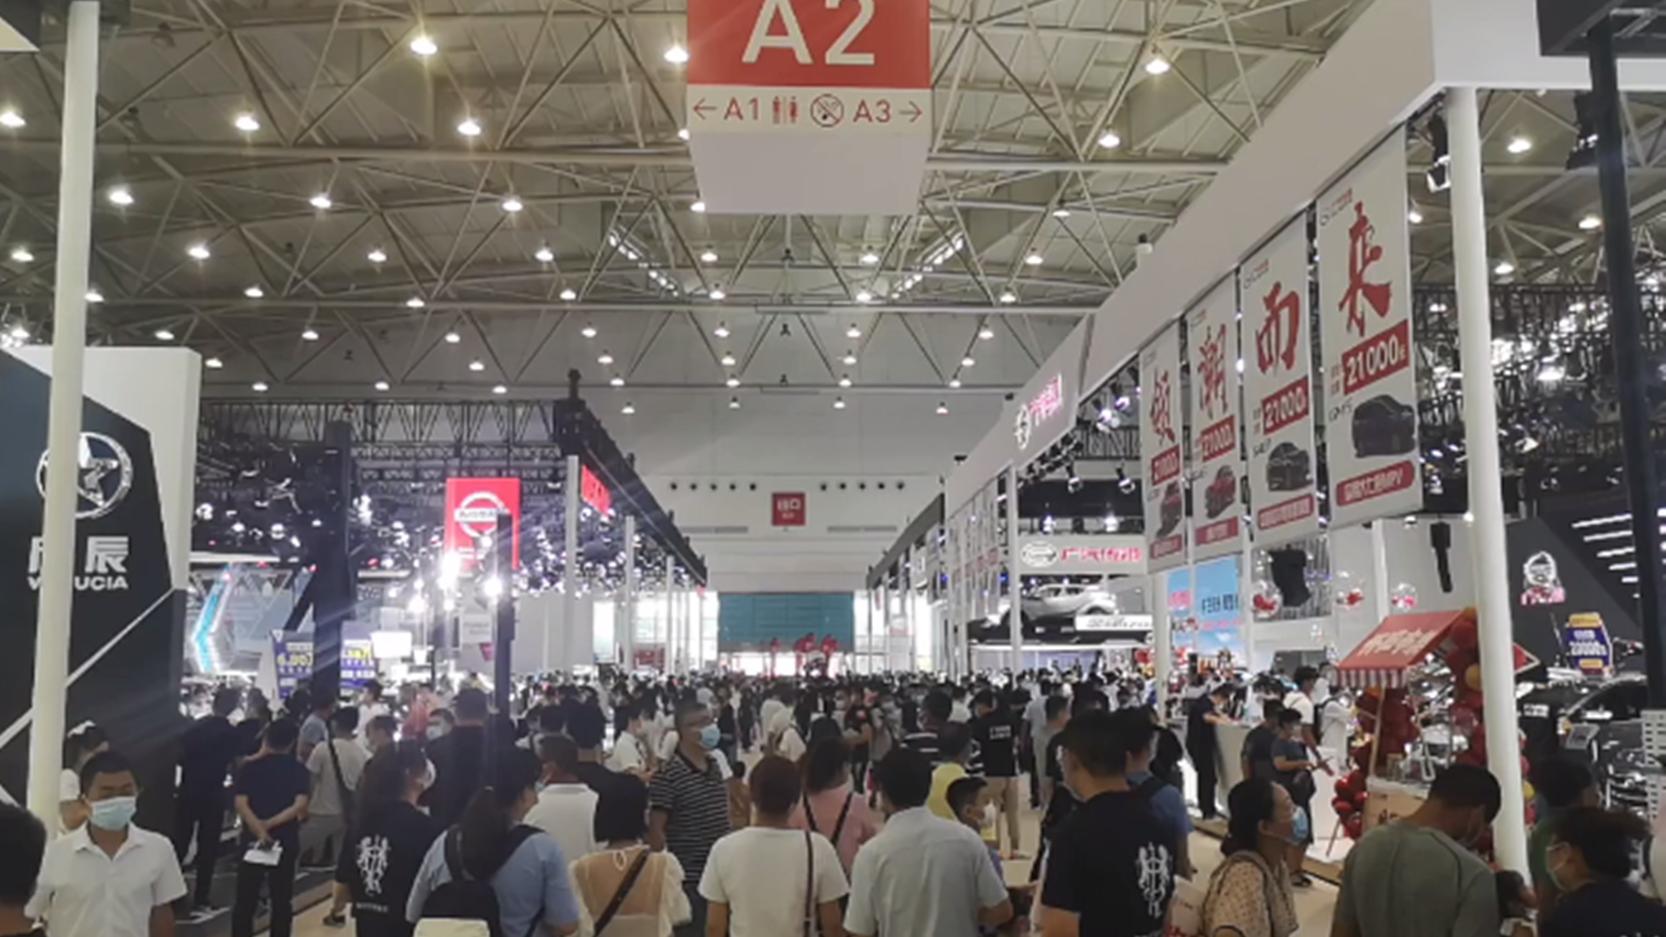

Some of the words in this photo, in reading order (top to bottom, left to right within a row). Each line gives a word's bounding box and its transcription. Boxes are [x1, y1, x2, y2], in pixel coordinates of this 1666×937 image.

[742, 0, 875, 65] A2
[723, 98, 759, 120] A1
[853, 100, 891, 122] A3
[1338, 201, 1392, 337] 来
[1256, 281, 1300, 375] 而
[27, 576, 128, 590] VUCIA
